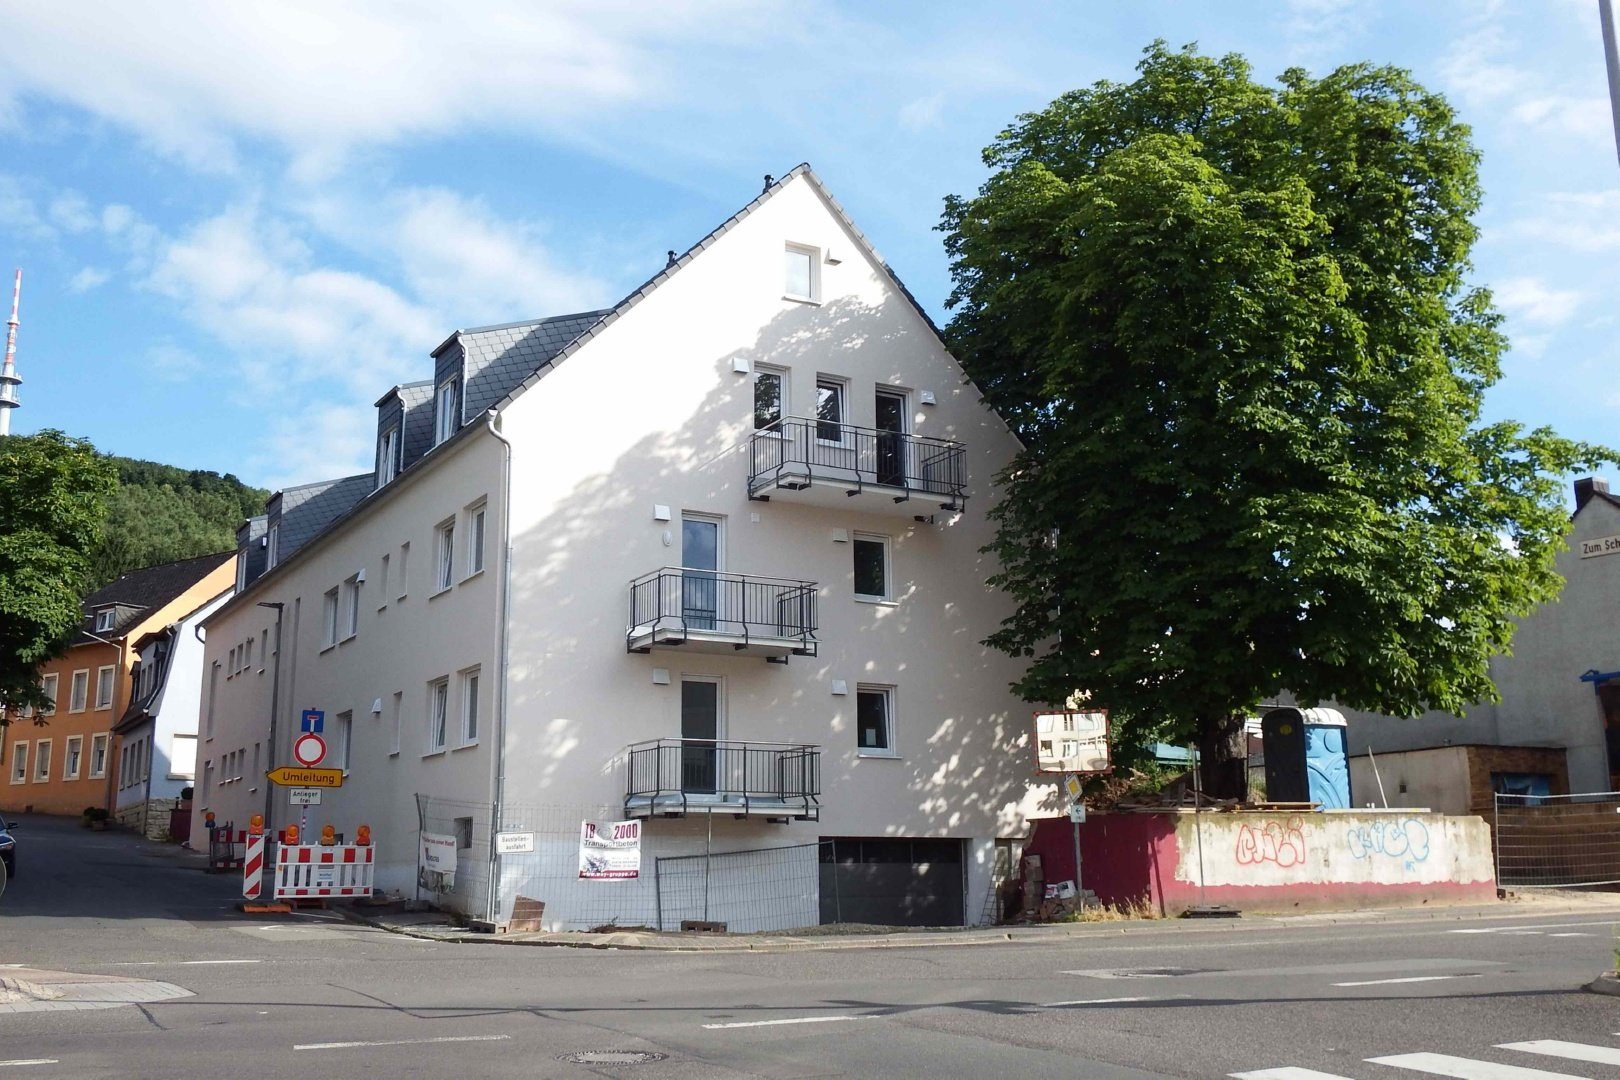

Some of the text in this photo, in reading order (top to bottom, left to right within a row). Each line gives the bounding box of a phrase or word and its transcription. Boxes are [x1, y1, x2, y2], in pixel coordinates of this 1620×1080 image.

[1583, 543, 1602, 554] Zum
[283, 772, 334, 785] Umleitung
[585, 823, 638, 840] TB 2000
[584, 840, 638, 848] Transportbeton
